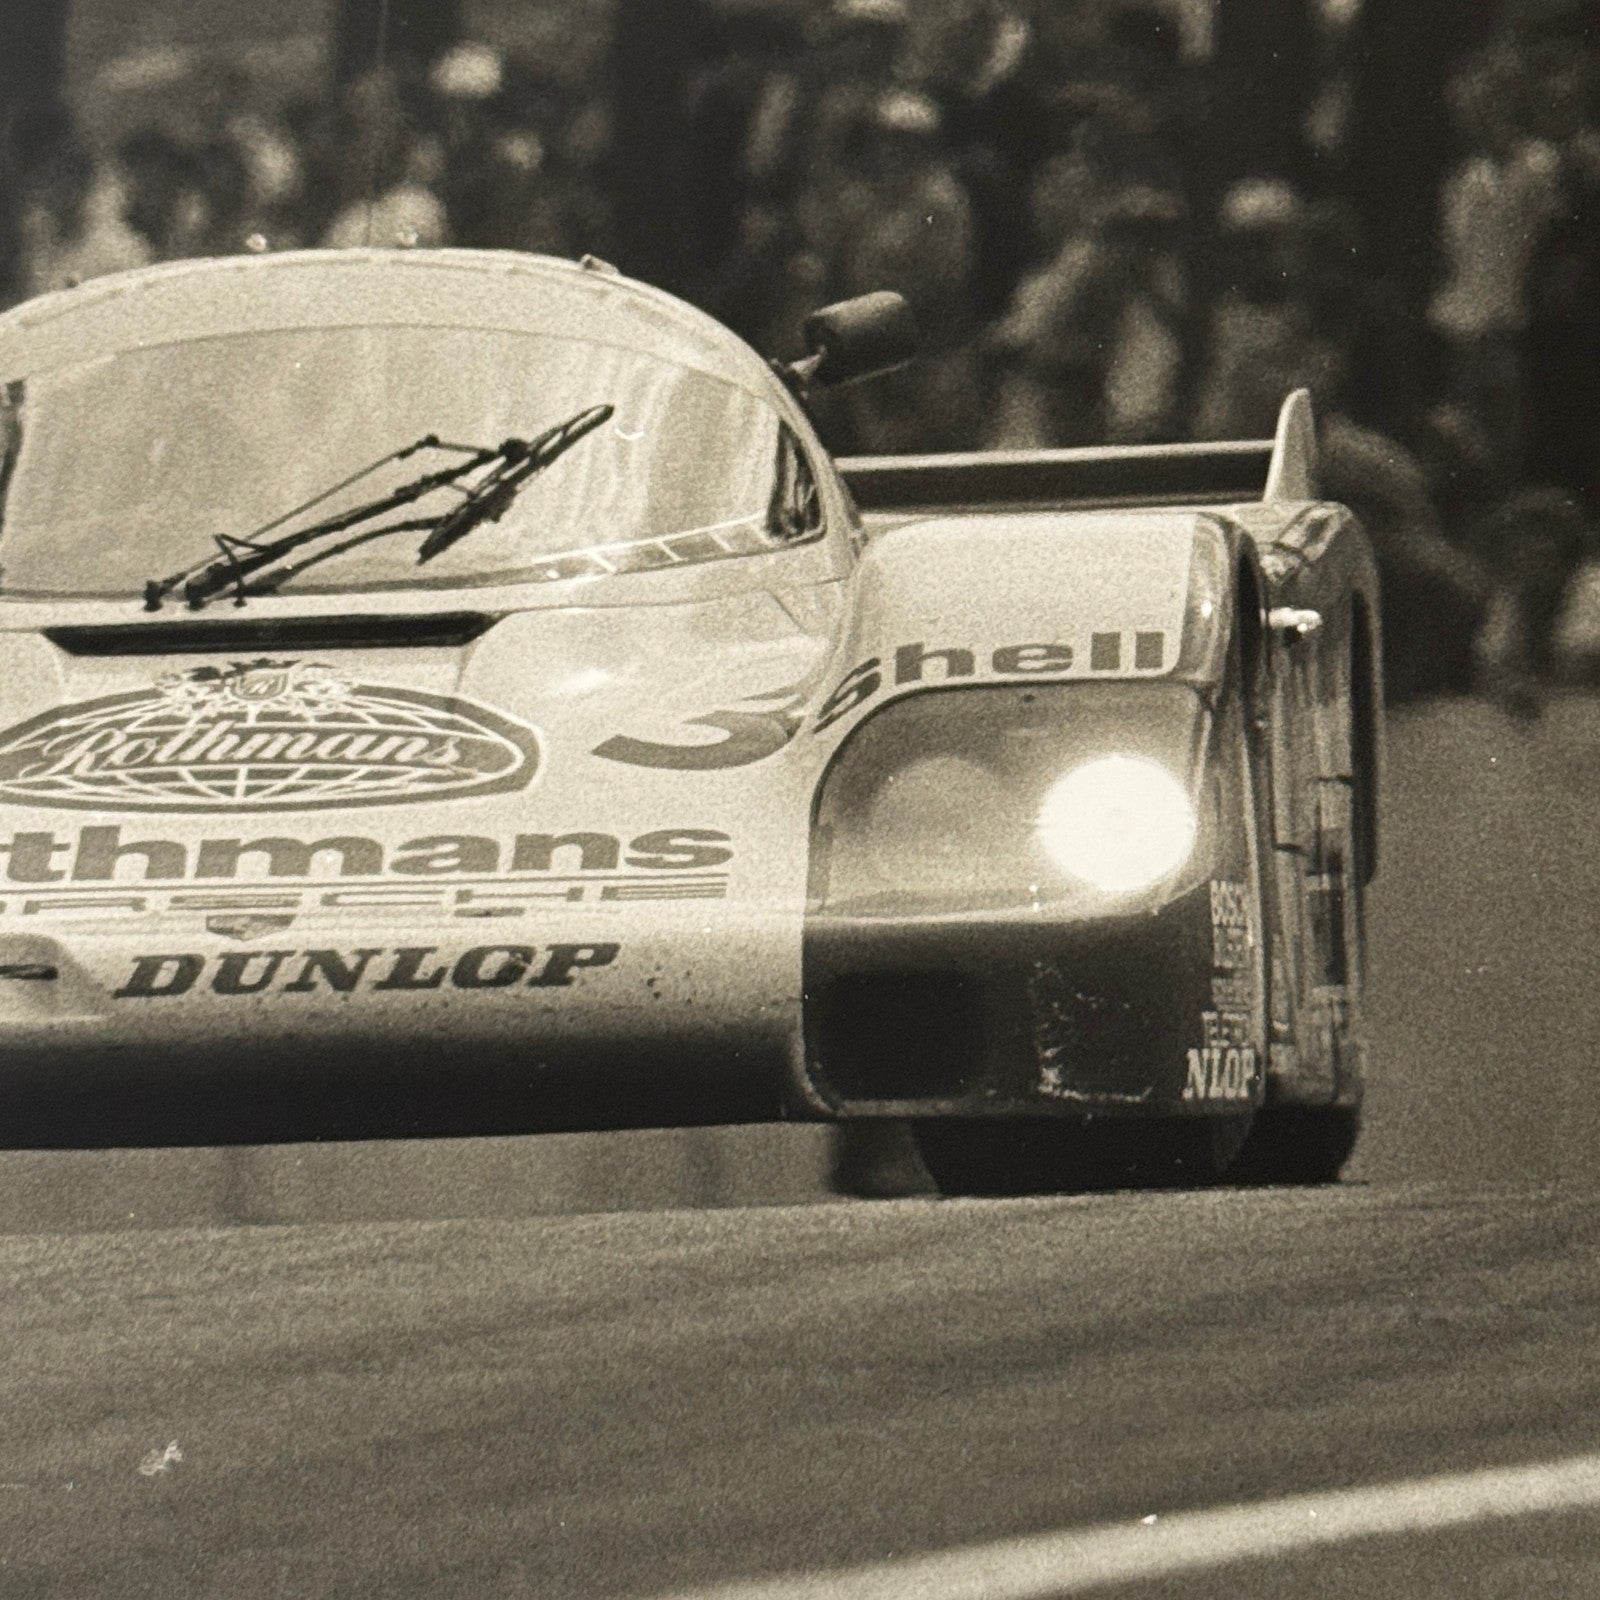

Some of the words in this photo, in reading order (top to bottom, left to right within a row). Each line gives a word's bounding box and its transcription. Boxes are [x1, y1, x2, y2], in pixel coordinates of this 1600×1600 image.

[811, 631, 1165, 734] Shell
[19, 718, 472, 779] Rothmans
[0, 822, 734, 884] thmans
[0, 882, 729, 915] RSCHE
[113, 942, 621, 999] DUNLOP
